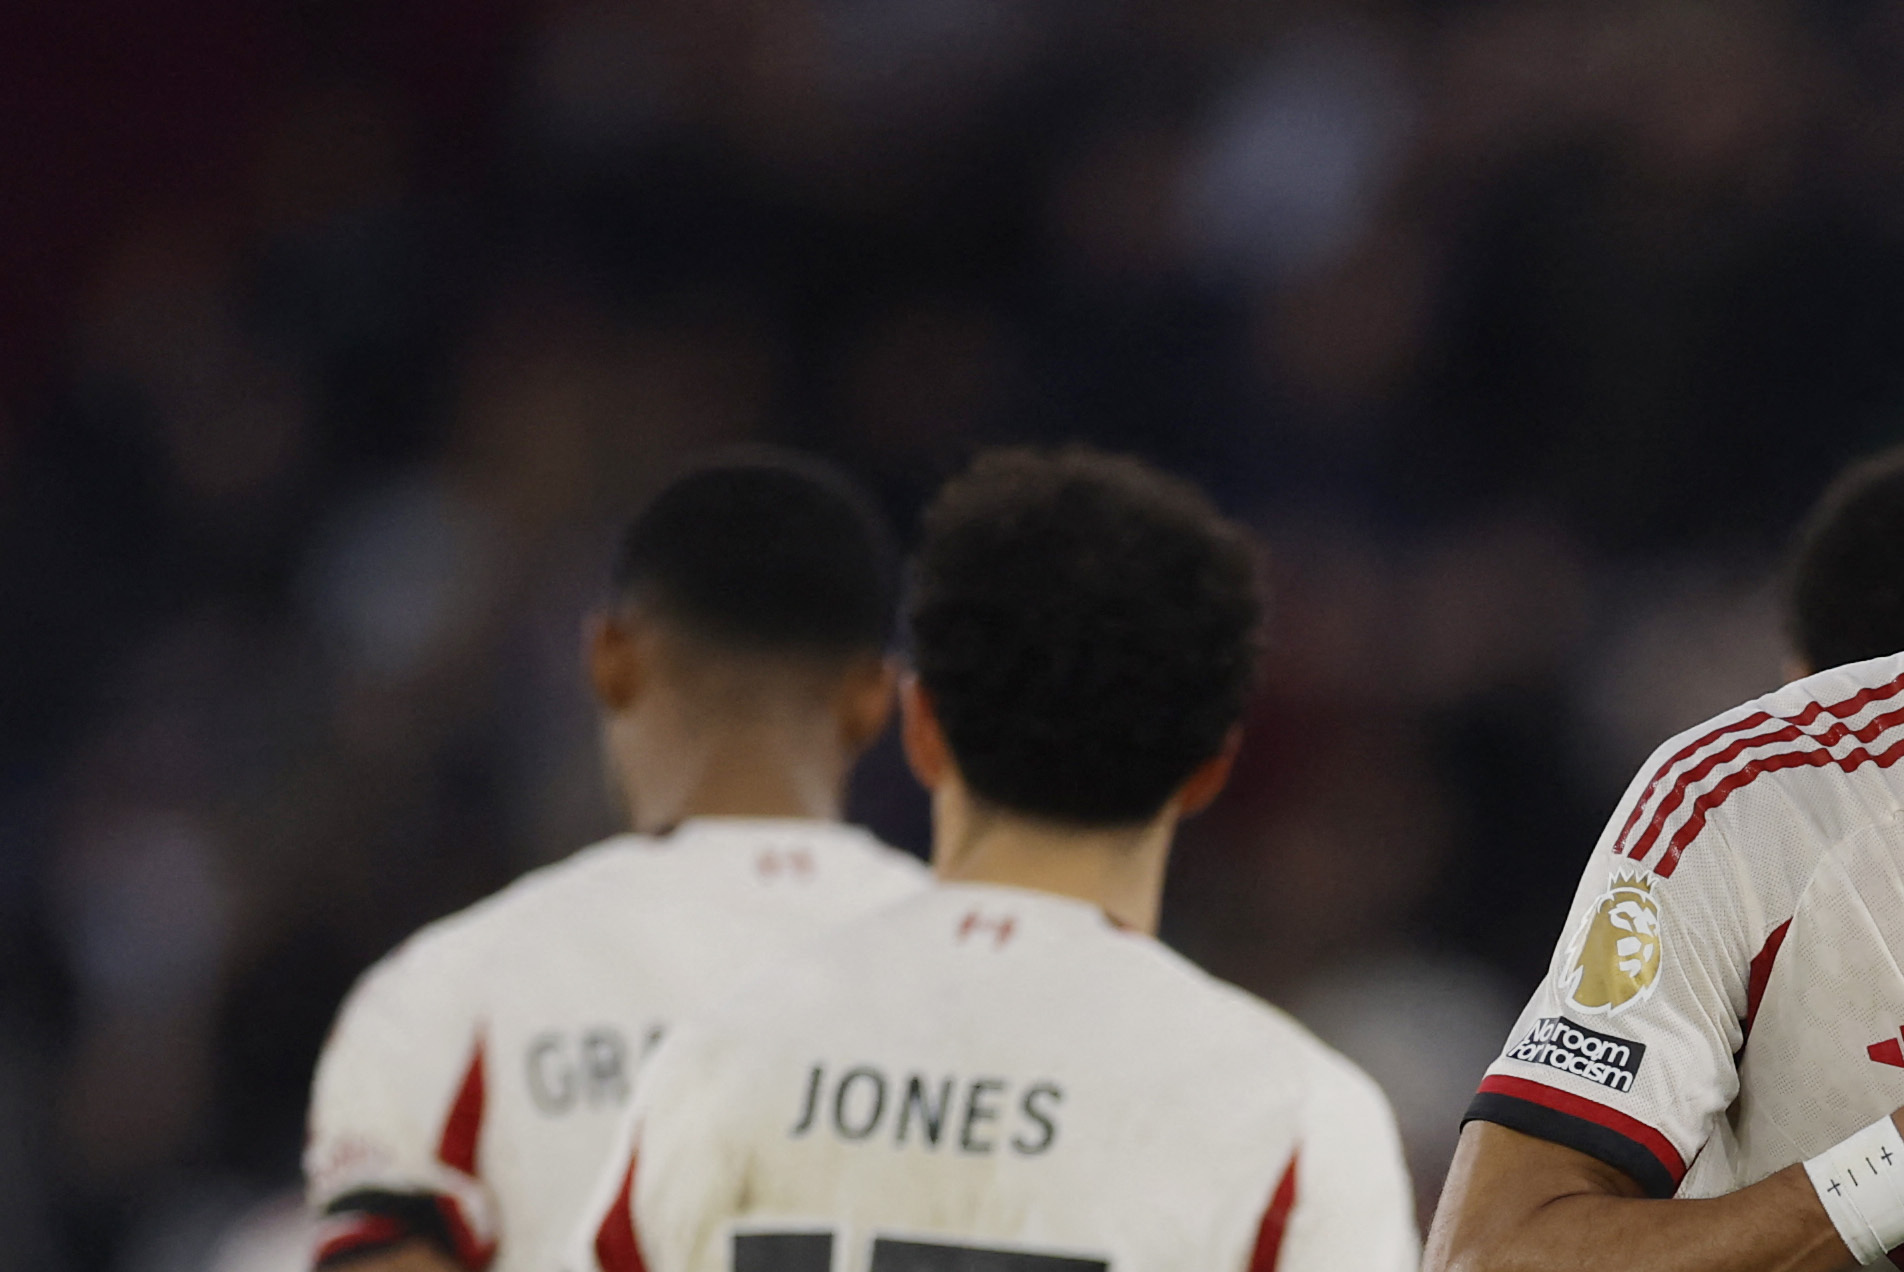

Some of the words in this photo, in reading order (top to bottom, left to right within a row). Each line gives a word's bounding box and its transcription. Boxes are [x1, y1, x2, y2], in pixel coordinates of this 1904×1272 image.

[1539, 1043, 1633, 1092] racism
[1551, 1022, 1630, 1067] room
[791, 1061, 1064, 1157] JONES
